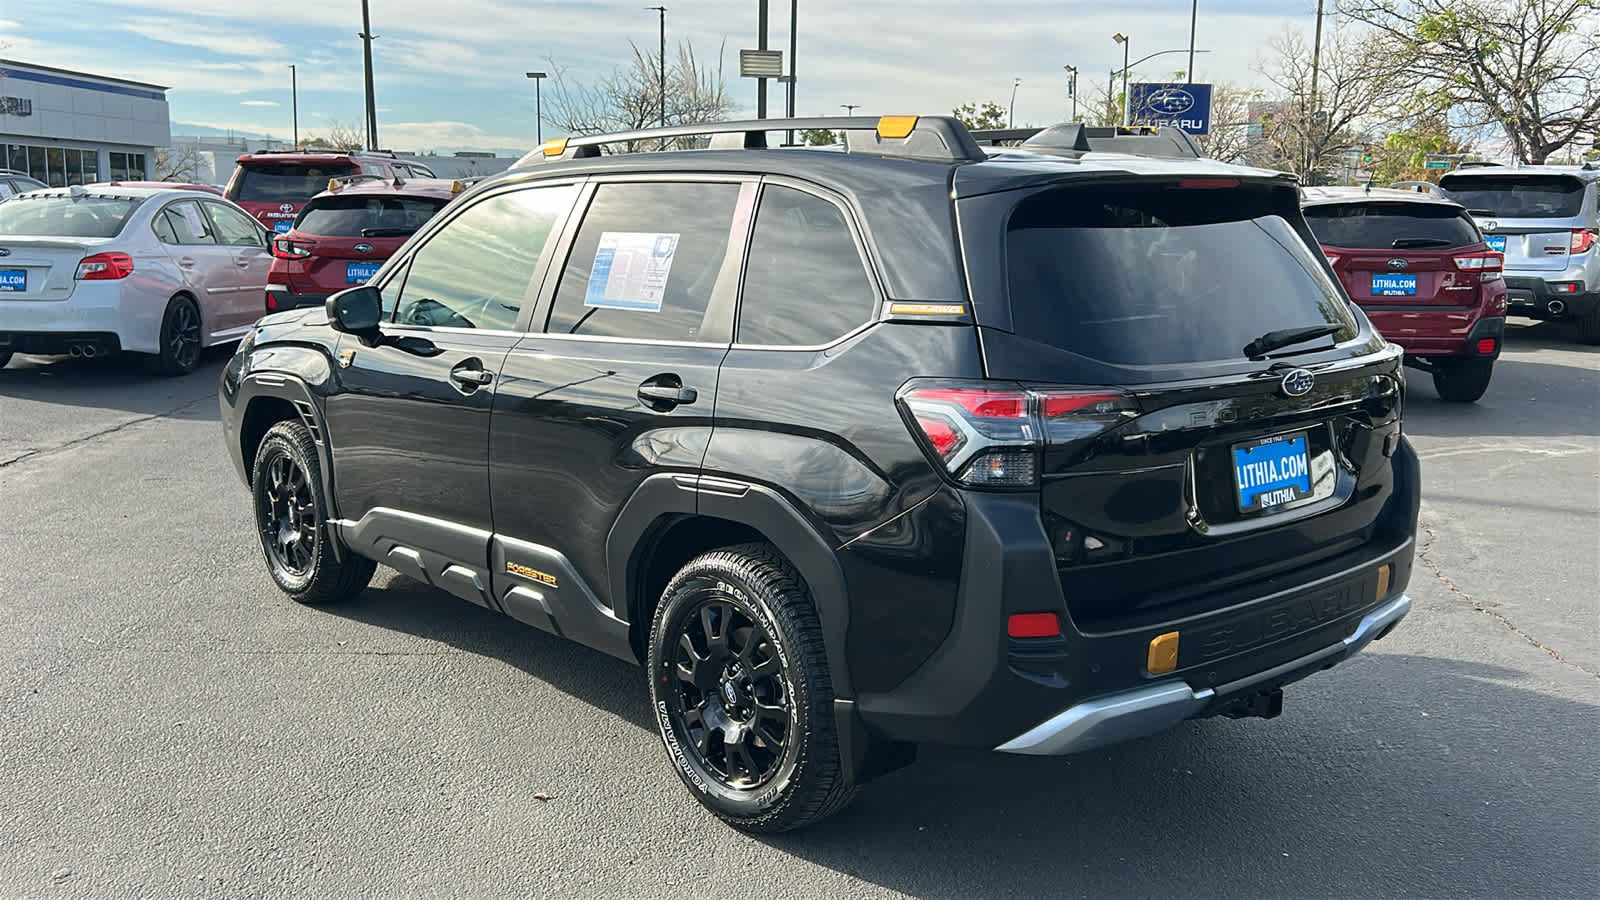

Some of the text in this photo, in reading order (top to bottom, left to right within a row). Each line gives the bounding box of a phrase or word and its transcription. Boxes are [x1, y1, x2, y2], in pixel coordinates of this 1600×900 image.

[1137, 119, 1203, 129] SUBARU
[347, 268, 376, 277] LITHIA.C
[1372, 279, 1416, 288] LITHIA.COM
[1236, 453, 1308, 489] LITHIA.COM
[1268, 487, 1296, 506] LITHIA
[506, 561, 557, 585] FORESTER
[716, 581, 789, 669] GEOLANDAR
[1201, 578, 1369, 658] SUBARU
[658, 700, 709, 795] YOKOHAMA
